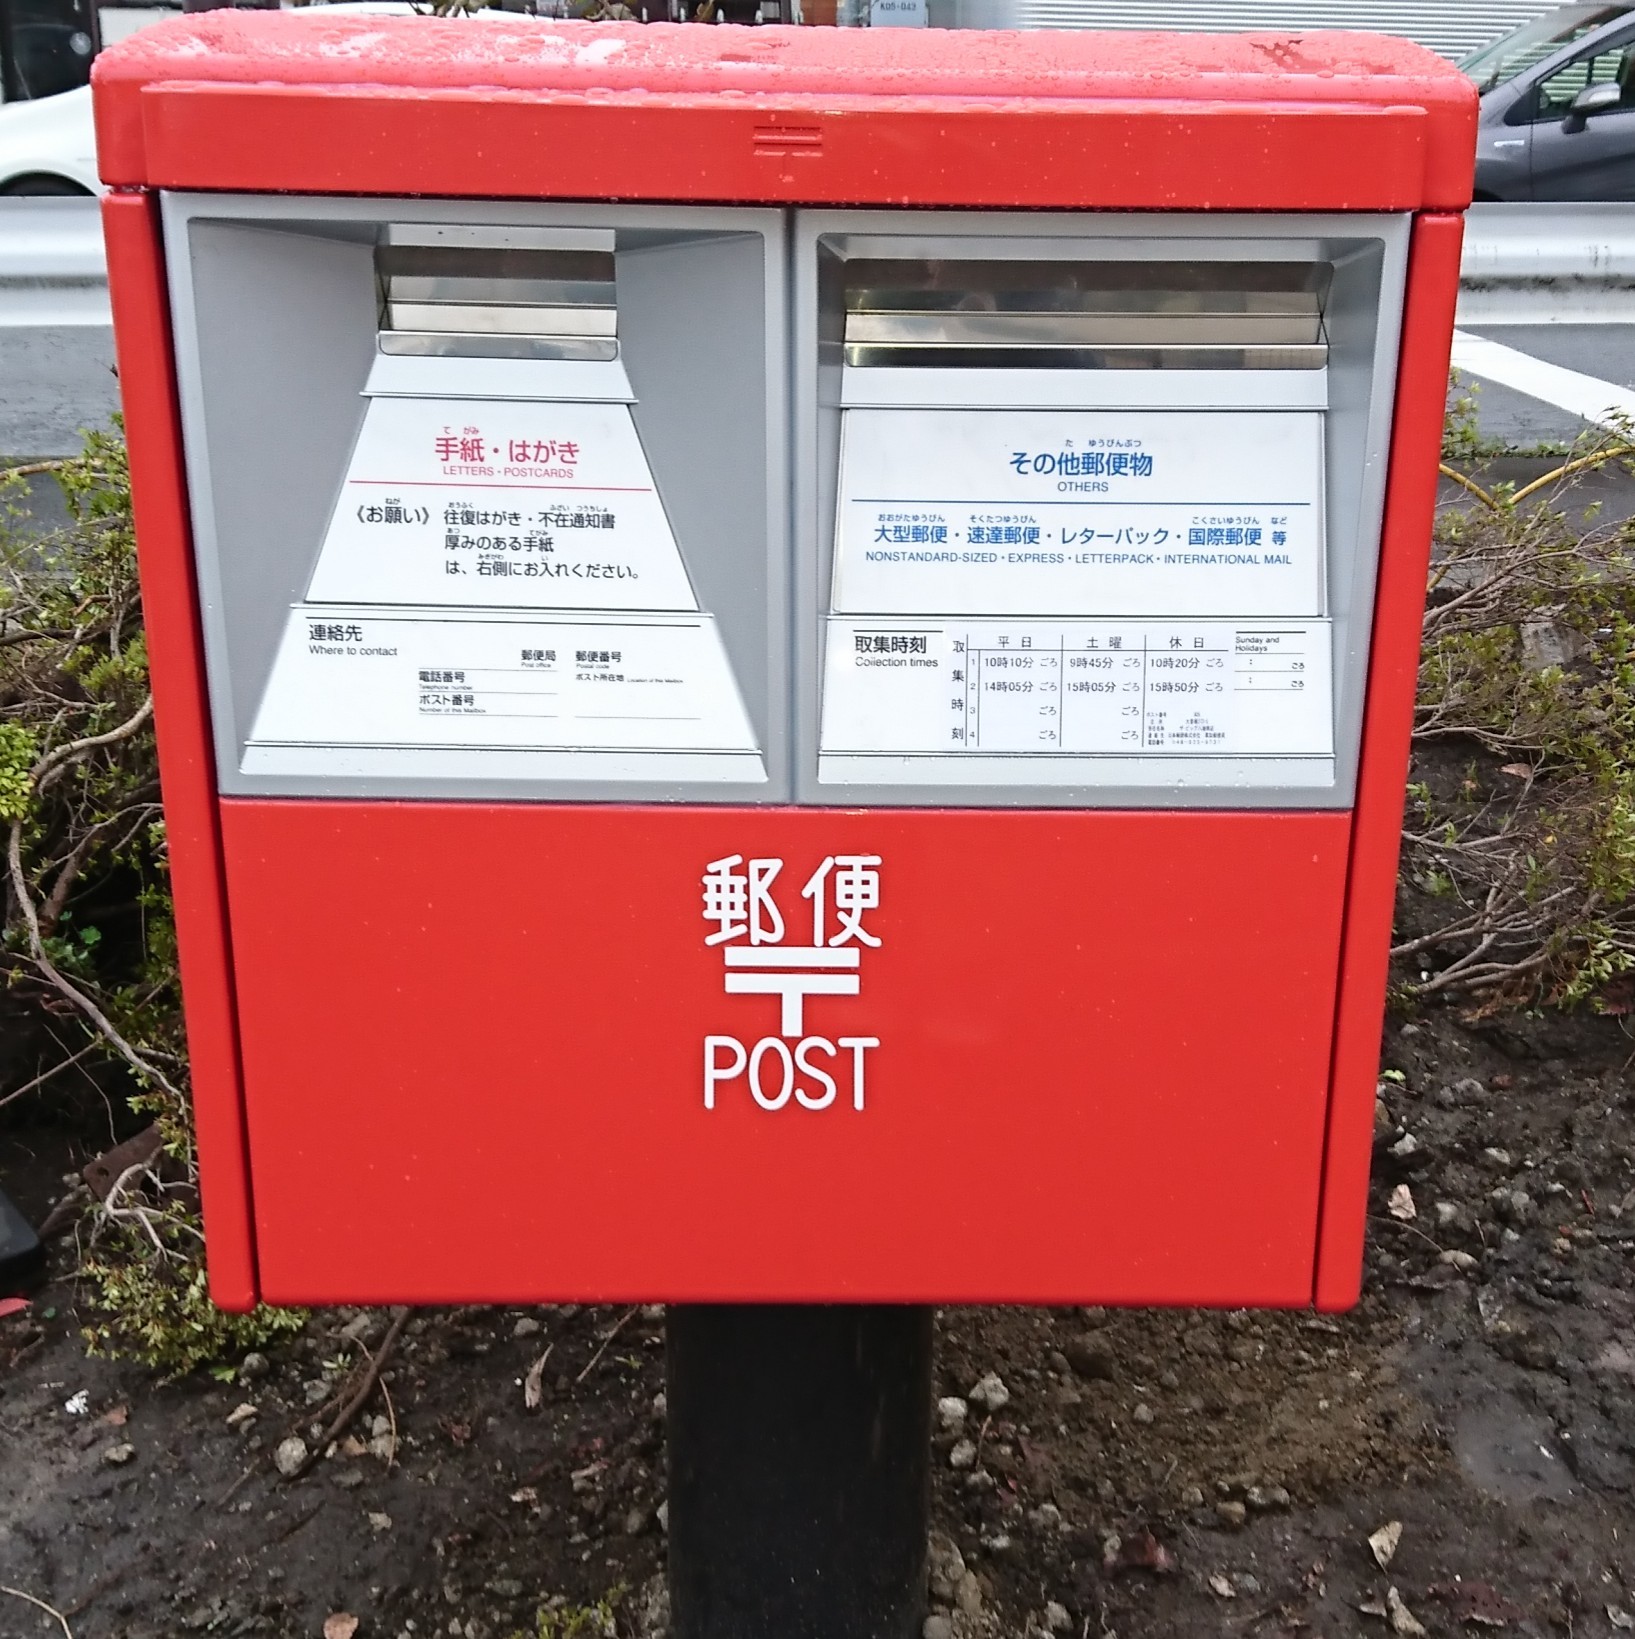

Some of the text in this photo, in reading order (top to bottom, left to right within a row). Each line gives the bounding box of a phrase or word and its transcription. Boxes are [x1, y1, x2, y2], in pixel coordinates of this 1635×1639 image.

[1088, 439, 1142, 448] ゆうびんぶつ
[435, 437, 580, 465] 手紙・はがき
[1009, 451, 1153, 478] その他郵便物
[443, 465, 575, 479] LETTERS POSTCARDS
[1057, 481, 1109, 493] OTHERS
[444, 533, 554, 553] 厚みのある手紙
[1008, 553, 1065, 564] EXPRESS
[1075, 553, 1154, 565] LETTERPACK
[1164, 554, 1261, 565] INTERNATIONAL
[1263, 554, 1293, 566] MAIL
[446, 559, 639, 580] は、右側にお入れください。
[308, 624, 363, 643] 連絡先
[855, 636, 927, 654] 取集時刻
[1235, 636, 1263, 645] Sunday
[309, 645, 398, 657] Where to contact
[521, 649, 556, 662] 郵便局
[575, 650, 622, 663] 郵便番号
[855, 657, 939, 668] Collection times
[984, 657, 1034, 669] 10時10分
[1040, 658, 1058, 668] ごろ
[1069, 657, 1141, 669] 9時45分 ごろ
[1150, 657, 1224, 669] 10時20分 ごろ
[418, 670, 466, 683] 電話番号
[984, 681, 1033, 692] 14時05分
[1039, 682, 1058, 692] ごろ
[1066, 681, 1141, 693] 15時05分 ごろ
[1149, 681, 1224, 693] 15時50分 ごろ
[419, 694, 475, 706] ポスト番号
[1038, 706, 1057, 716] ごろ
[1121, 706, 1140, 716] ごろ
[1038, 730, 1057, 740] ごろ
[1120, 730, 1139, 740] ごろ
[702, 854, 883, 948] 郵便
[704, 1035, 881, 1111] POST
